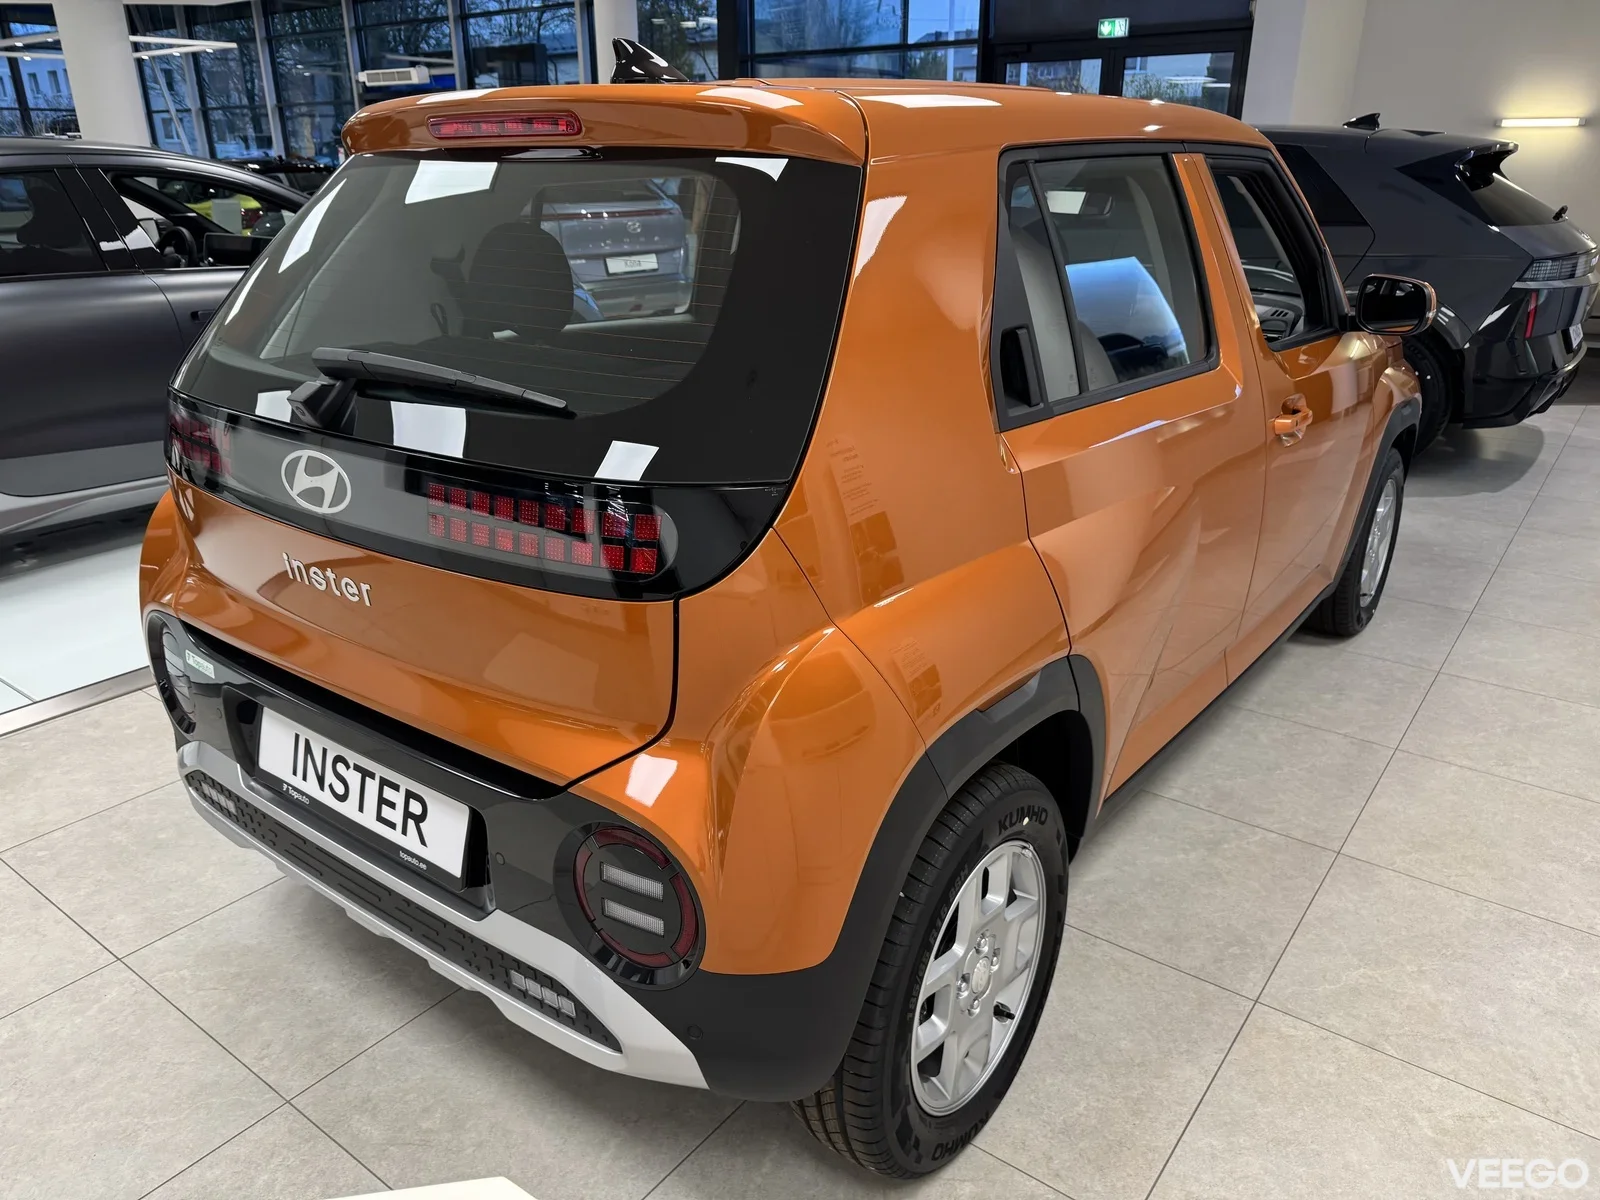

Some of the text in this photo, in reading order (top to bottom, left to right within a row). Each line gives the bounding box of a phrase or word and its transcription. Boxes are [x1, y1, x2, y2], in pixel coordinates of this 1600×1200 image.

[282, 552, 371, 607] inster
[288, 785, 310, 805] Topauto
[292, 732, 428, 848] INSTER
[998, 805, 1048, 836] KUMHO
[399, 850, 427, 871] topauto.ee
